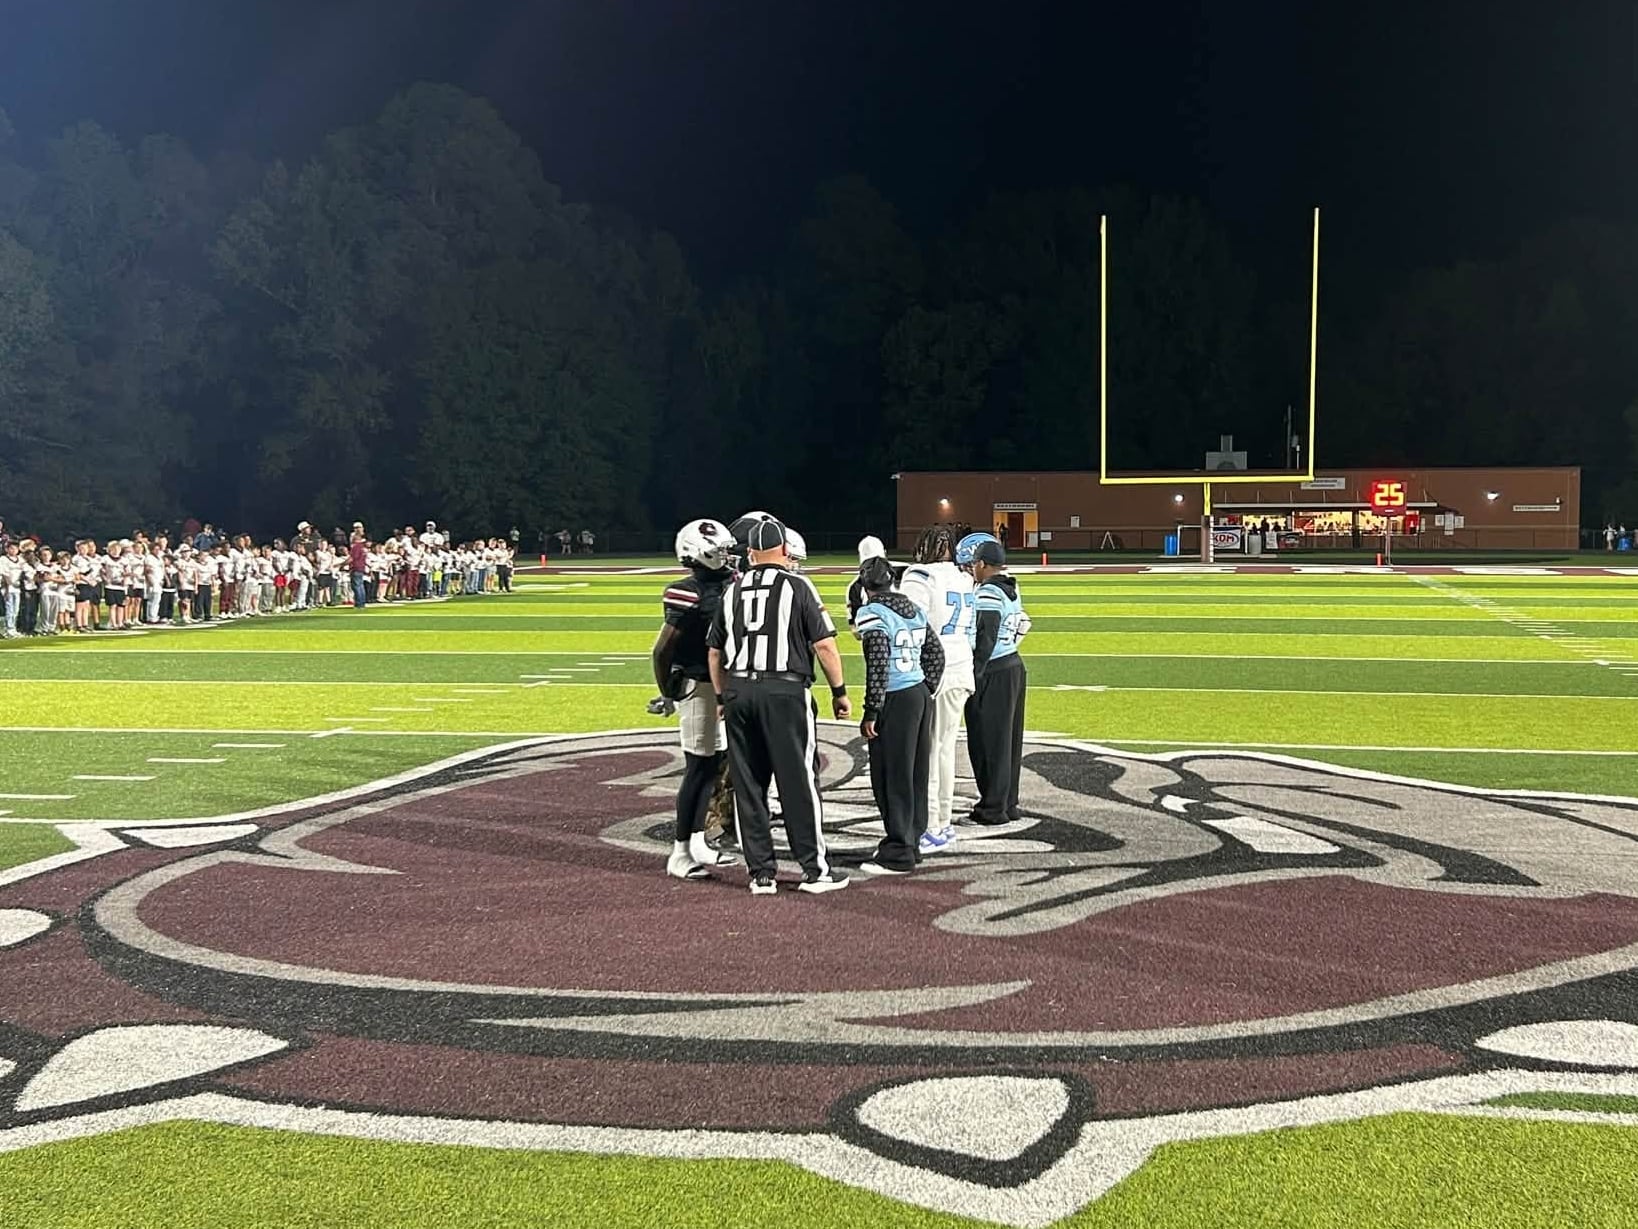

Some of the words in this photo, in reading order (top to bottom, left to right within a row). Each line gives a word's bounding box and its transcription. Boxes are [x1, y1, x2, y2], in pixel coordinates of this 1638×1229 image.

[1375, 483, 1404, 506] 25
[741, 588, 770, 631] U
[940, 591, 976, 635] 77
[894, 626, 928, 673] 37
